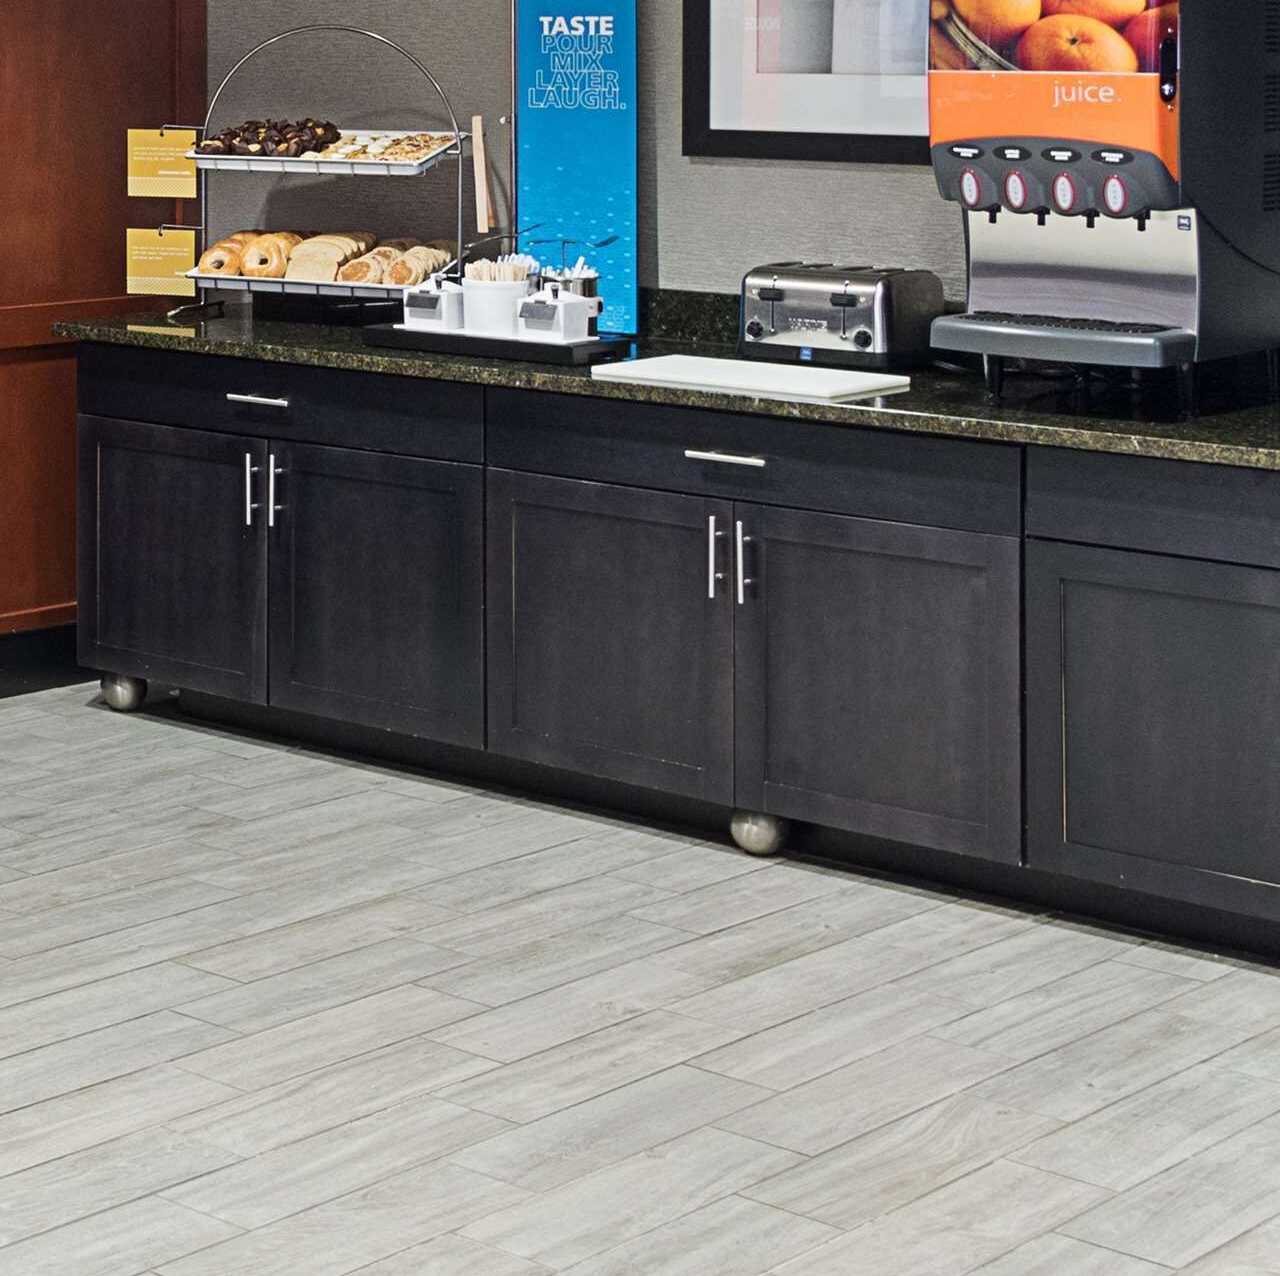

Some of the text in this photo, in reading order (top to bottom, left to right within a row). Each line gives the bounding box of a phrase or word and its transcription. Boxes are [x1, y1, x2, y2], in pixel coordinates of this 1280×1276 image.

[539, 16, 614, 36] TASTE
[541, 34, 613, 54] POUR
[551, 52, 603, 72] MIX
[536, 69, 619, 90] LAYER
[528, 88, 627, 110] LAUGH.
[1052, 79, 1123, 108] juice.
